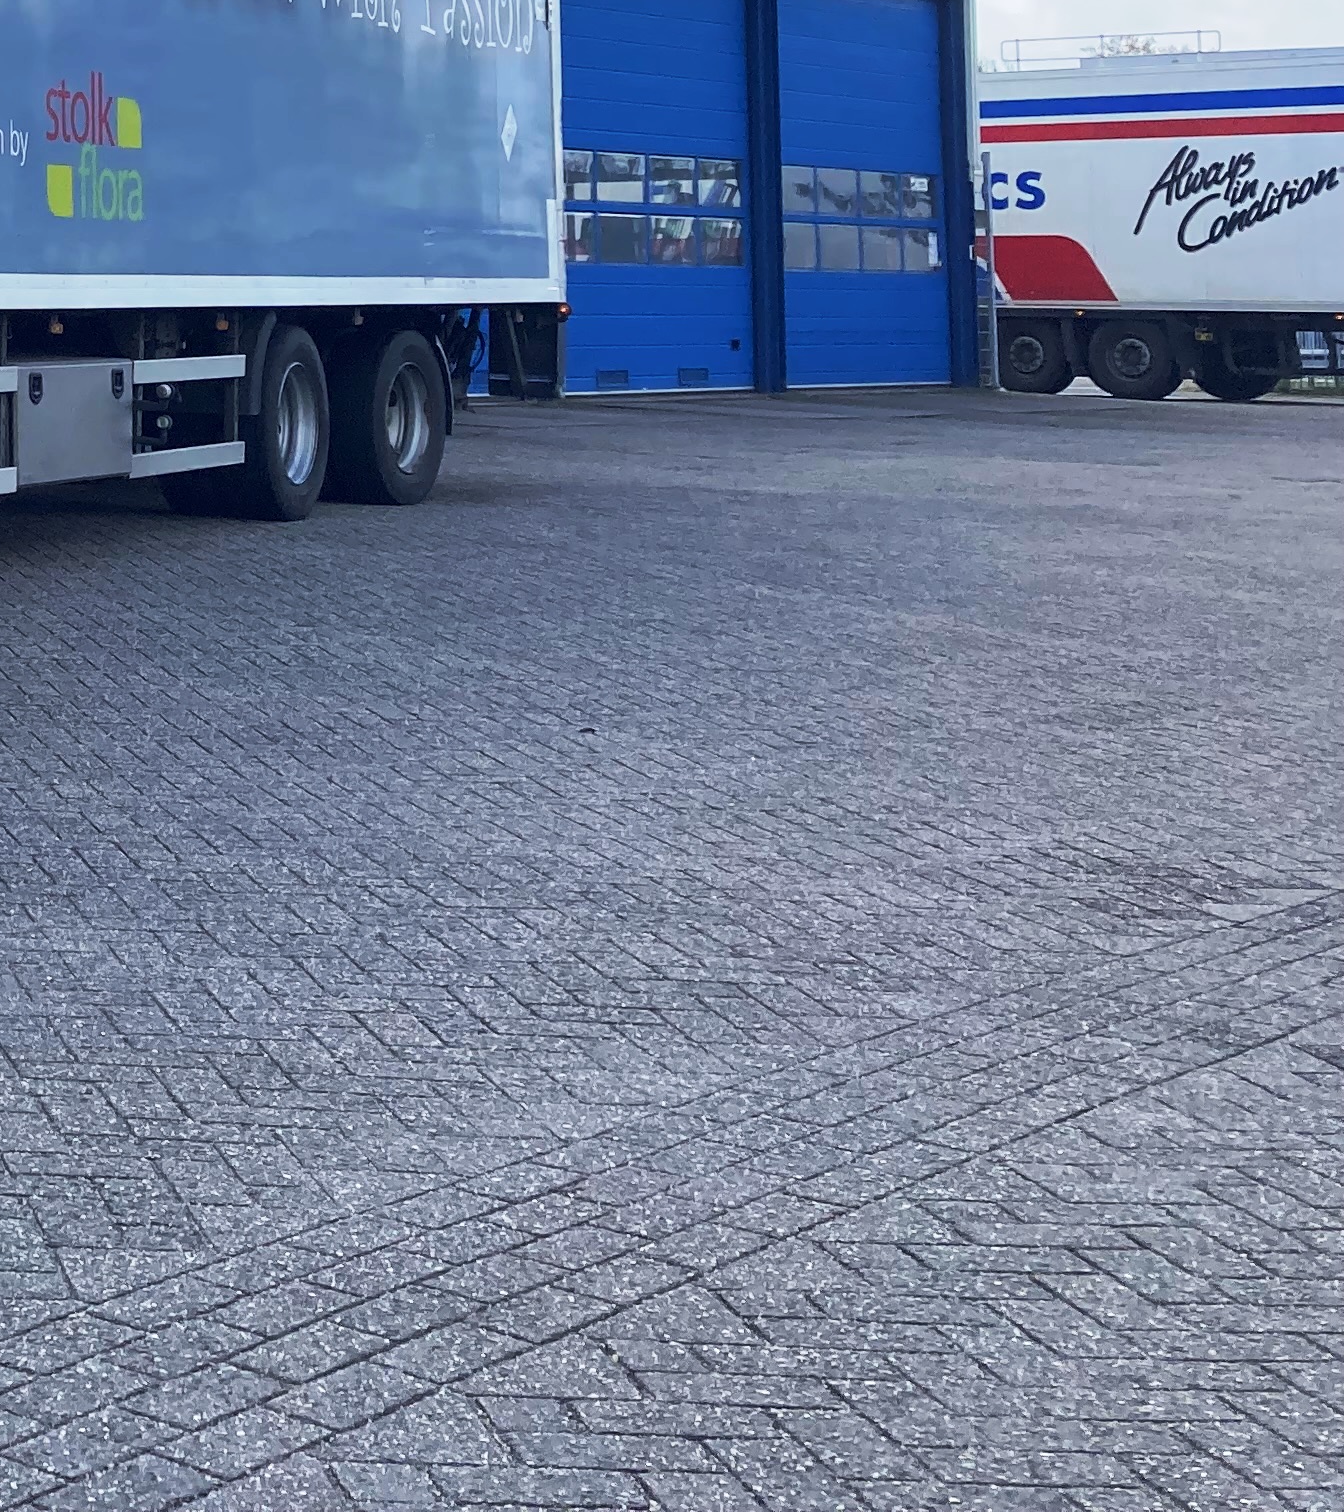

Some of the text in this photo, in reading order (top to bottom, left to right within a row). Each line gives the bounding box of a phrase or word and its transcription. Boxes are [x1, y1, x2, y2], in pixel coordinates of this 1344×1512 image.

[10, 119, 29, 167] by
[46, 71, 116, 147] stolk
[78, 142, 145, 221] flora
[1133, 144, 1256, 236] Always
[1177, 166, 1340, 253] Condition
[1228, 178, 1259, 207] in
